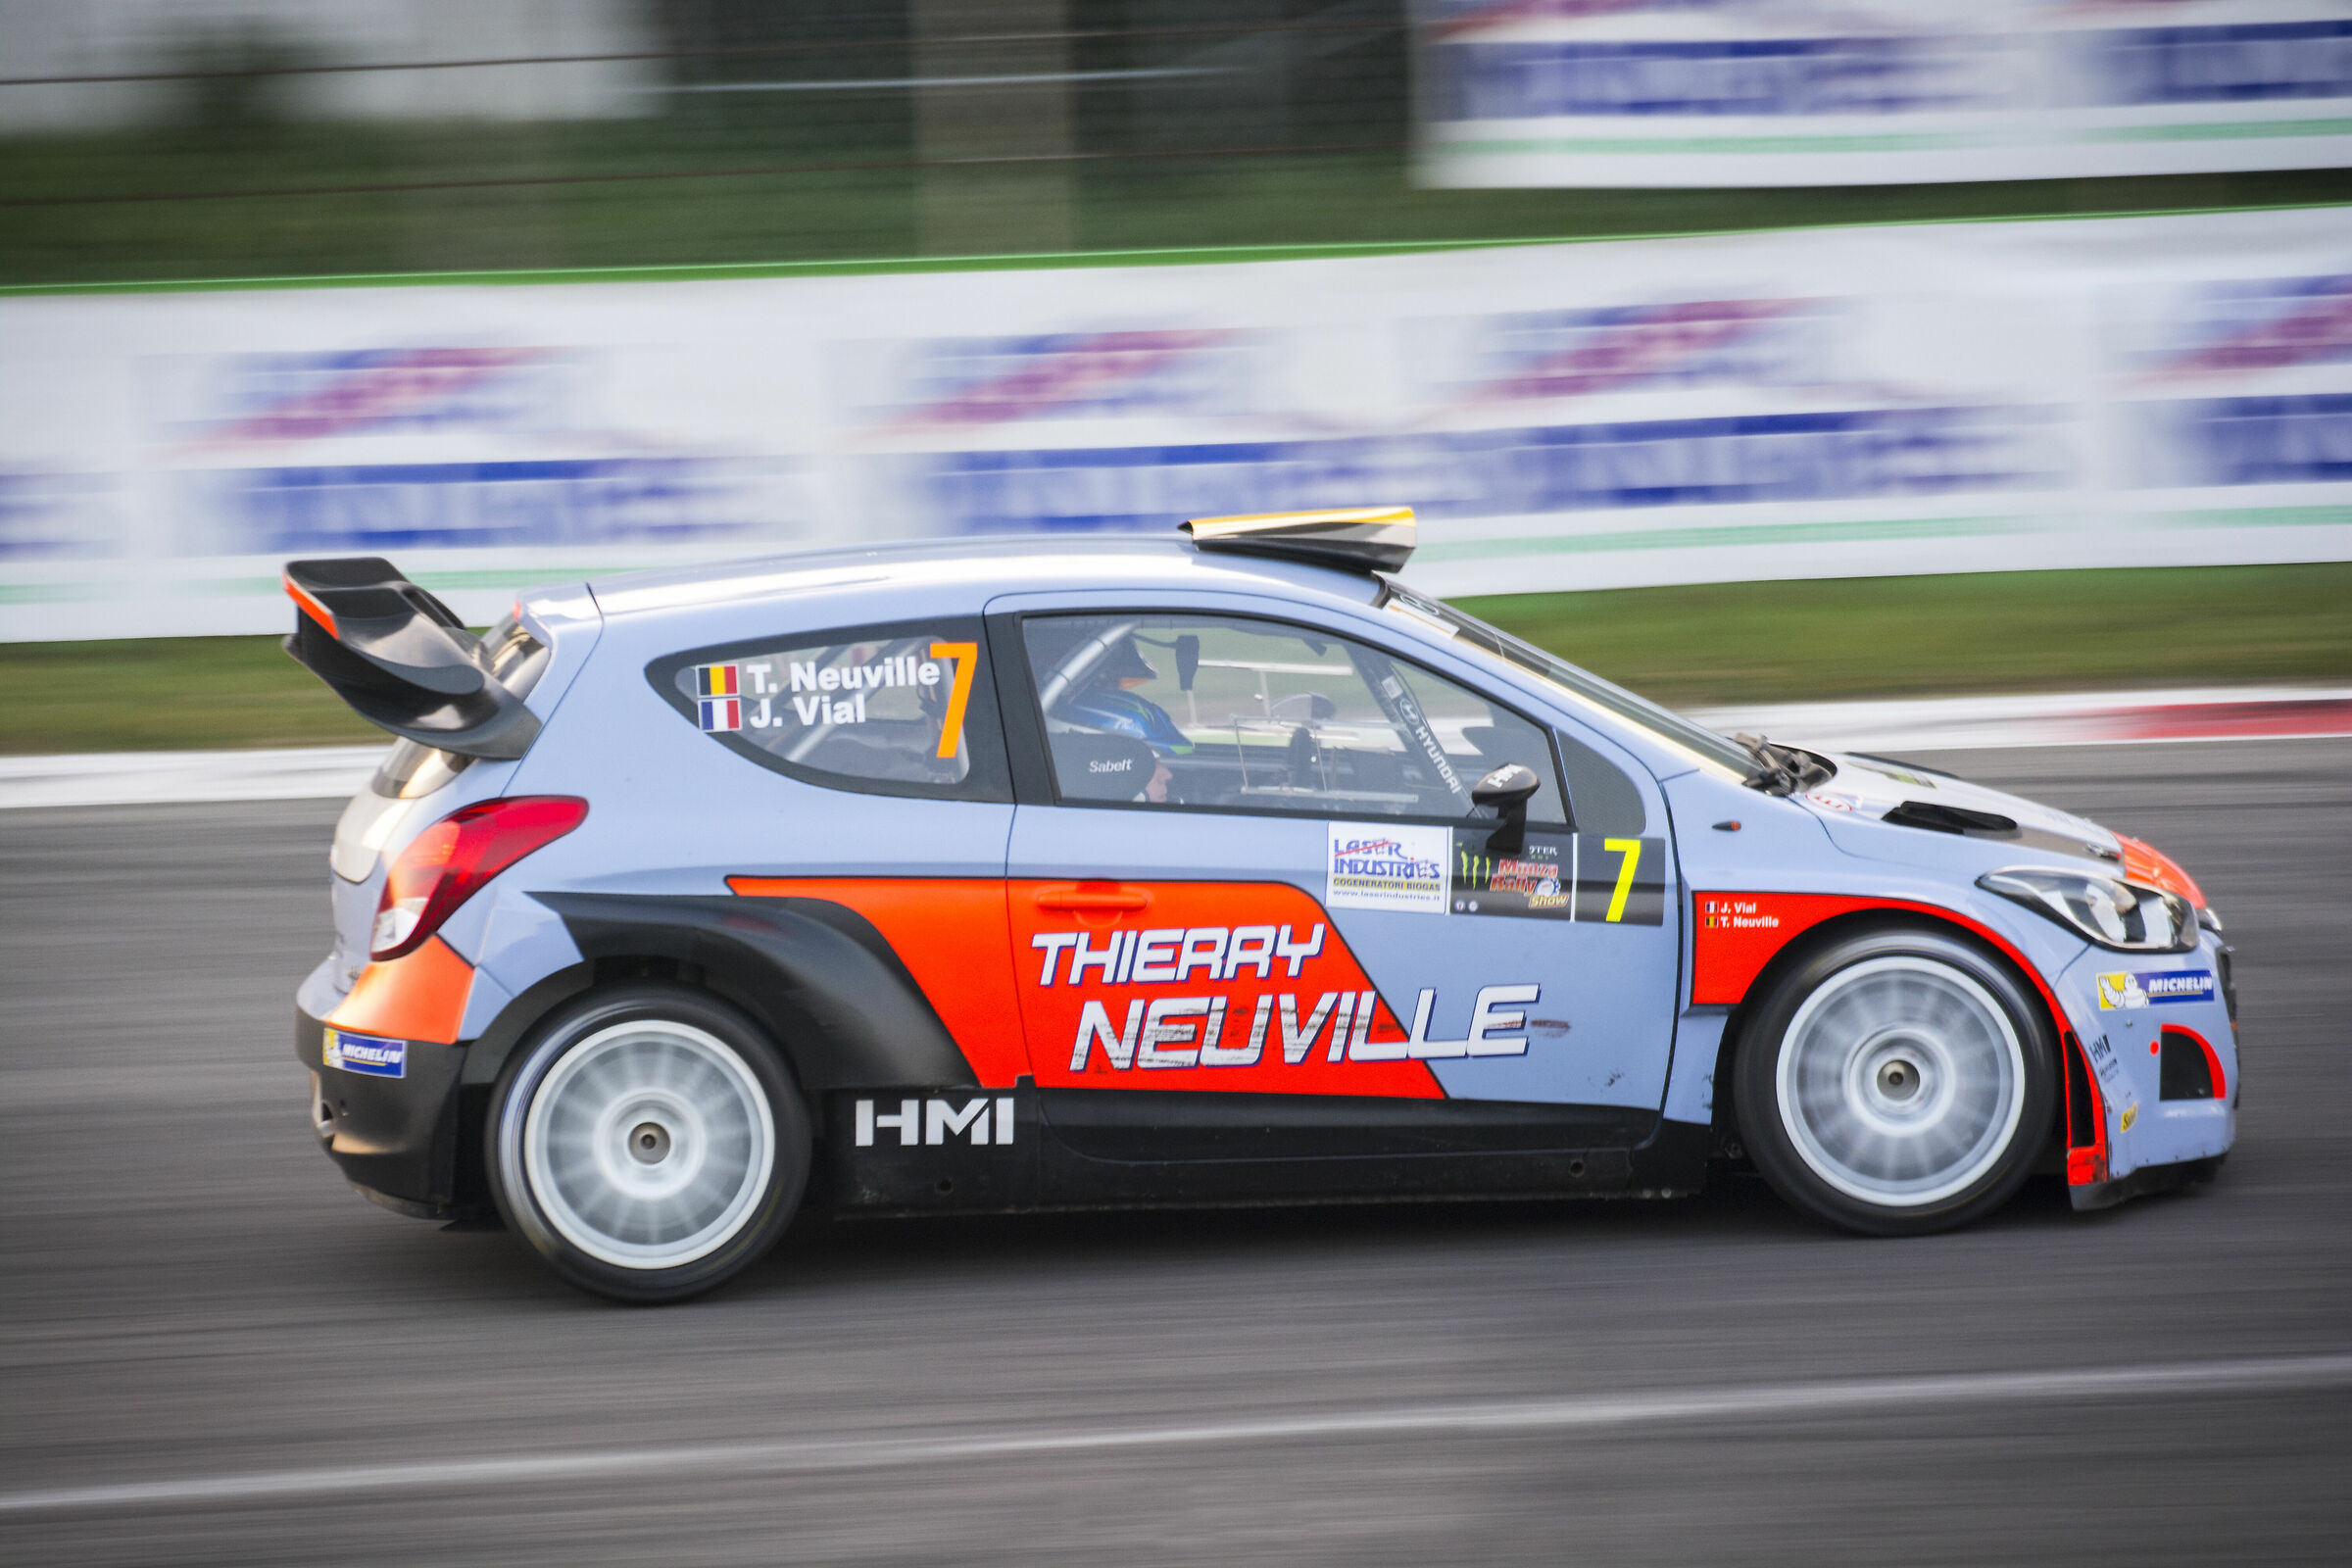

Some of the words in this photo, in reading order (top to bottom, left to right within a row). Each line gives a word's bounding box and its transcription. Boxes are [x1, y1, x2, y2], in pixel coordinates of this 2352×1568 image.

[746, 663, 777, 695] T.
[789, 656, 941, 693] Neuville
[750, 698, 782, 729] J.
[793, 694, 866, 726] Vial
[930, 642, 977, 759] 7
[1089, 759, 1133, 773] Sabelt
[1415, 726, 1461, 795] HYUNDAI
[1490, 873, 1537, 897] Rally
[1497, 858, 1558, 878] Monza
[1604, 839, 1641, 922] 7
[1734, 915, 1779, 928] Neuville
[1735, 902, 1756, 913] Vial
[1031, 923, 1325, 986] THIERRY
[2148, 976, 2214, 993] MICHELIN
[1069, 983, 1540, 1073] NEUVILLE
[343, 1044, 402, 1063] MICHELIN
[855, 1098, 1014, 1147] HMI
